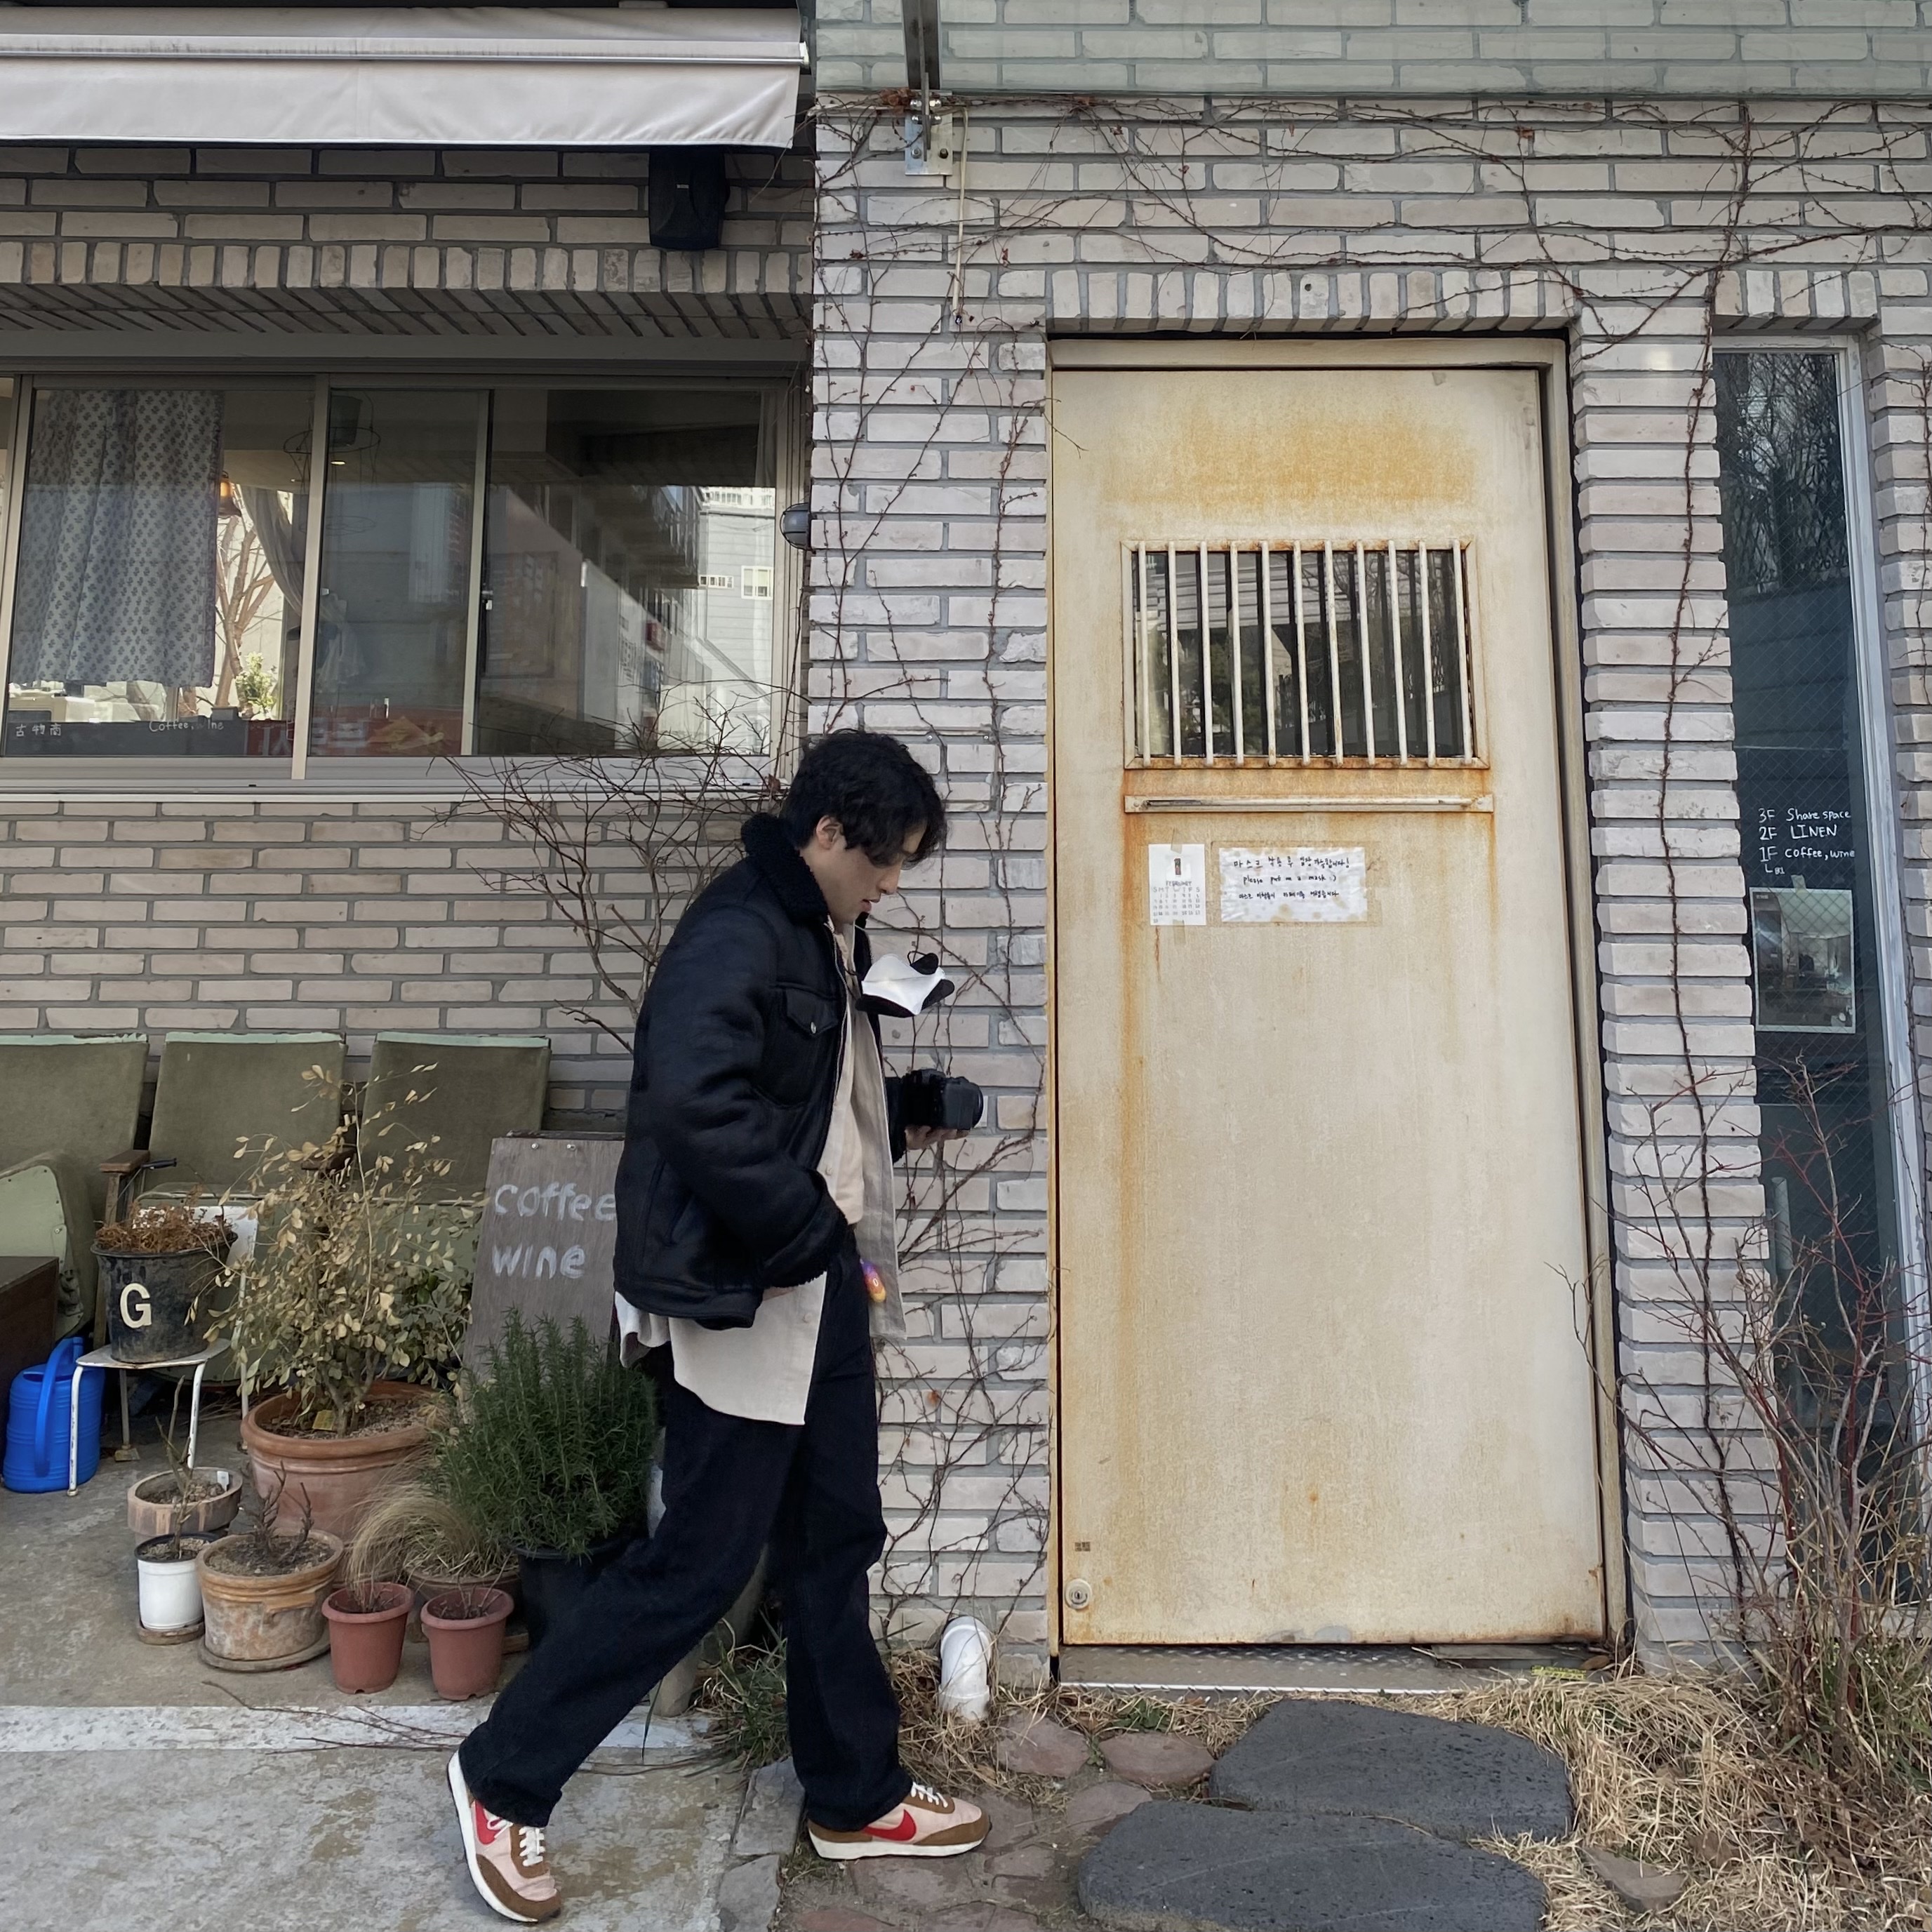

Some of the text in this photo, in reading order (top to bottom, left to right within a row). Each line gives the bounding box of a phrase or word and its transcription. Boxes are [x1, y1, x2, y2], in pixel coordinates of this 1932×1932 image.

[1758, 808, 1851, 823] 3F Share space
[1759, 824, 1837, 841] 2F LINEN
[1233, 859, 1263, 869] 마스크
[1268, 856, 1281, 867] 착용
[1287, 855, 1293, 868] 후
[1759, 846, 1778, 862] 1F
[493, 1241, 585, 1279] wine
[120, 1282, 152, 1328] G
